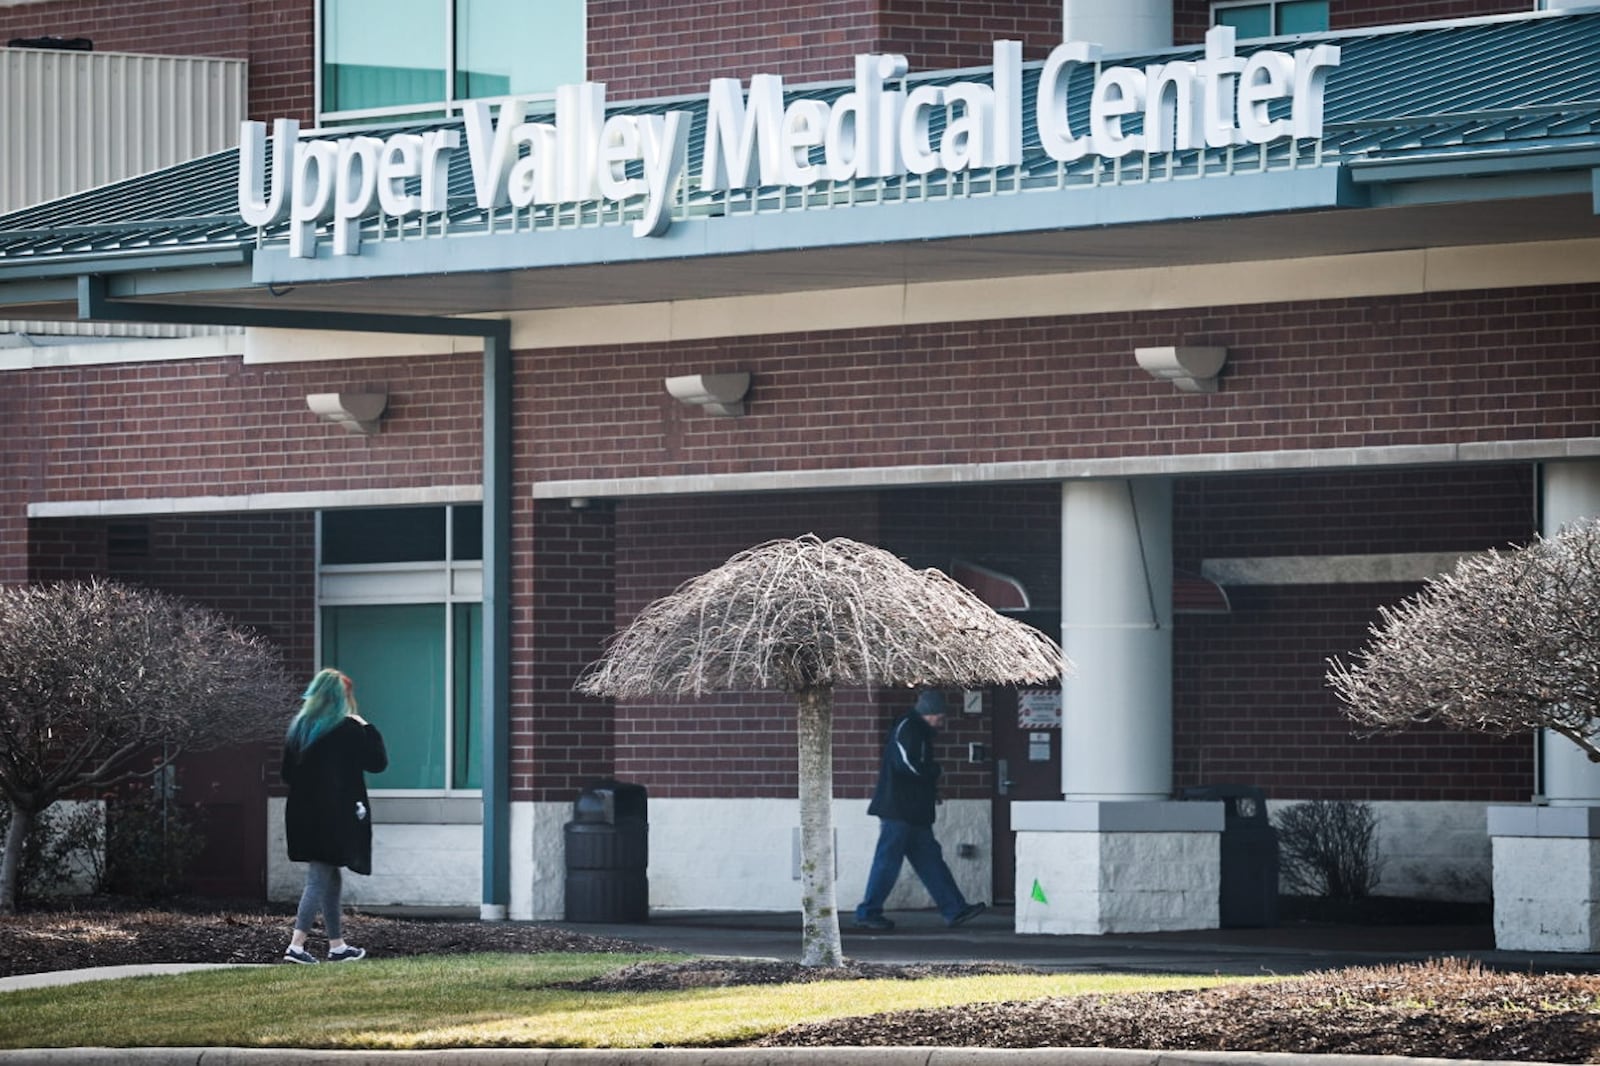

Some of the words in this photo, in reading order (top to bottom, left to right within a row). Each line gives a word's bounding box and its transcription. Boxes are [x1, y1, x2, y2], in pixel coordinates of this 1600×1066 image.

[238, 118, 460, 259] Upper
[463, 82, 693, 239] Valley
[700, 40, 1023, 192] Medical
[1036, 25, 1341, 163] Center
